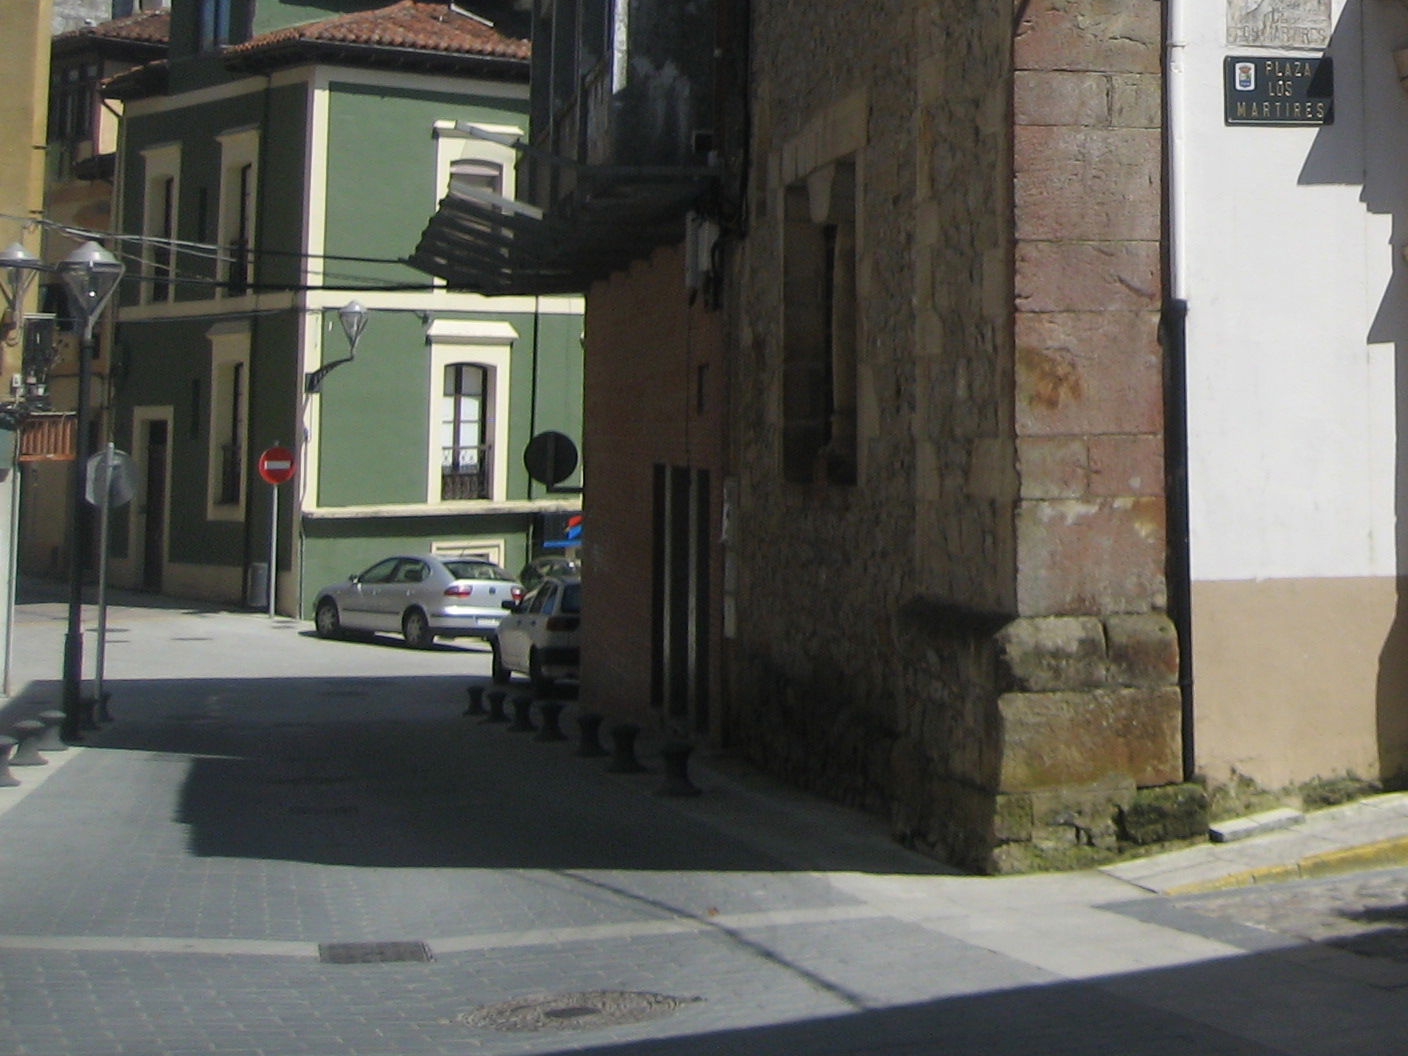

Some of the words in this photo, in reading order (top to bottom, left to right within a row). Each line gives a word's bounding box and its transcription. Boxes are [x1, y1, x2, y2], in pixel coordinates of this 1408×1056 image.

[1264, 60, 1312, 77] PLAZA
[1268, 80, 1293, 97] LOS
[1236, 101, 1325, 118] MARTIRES
